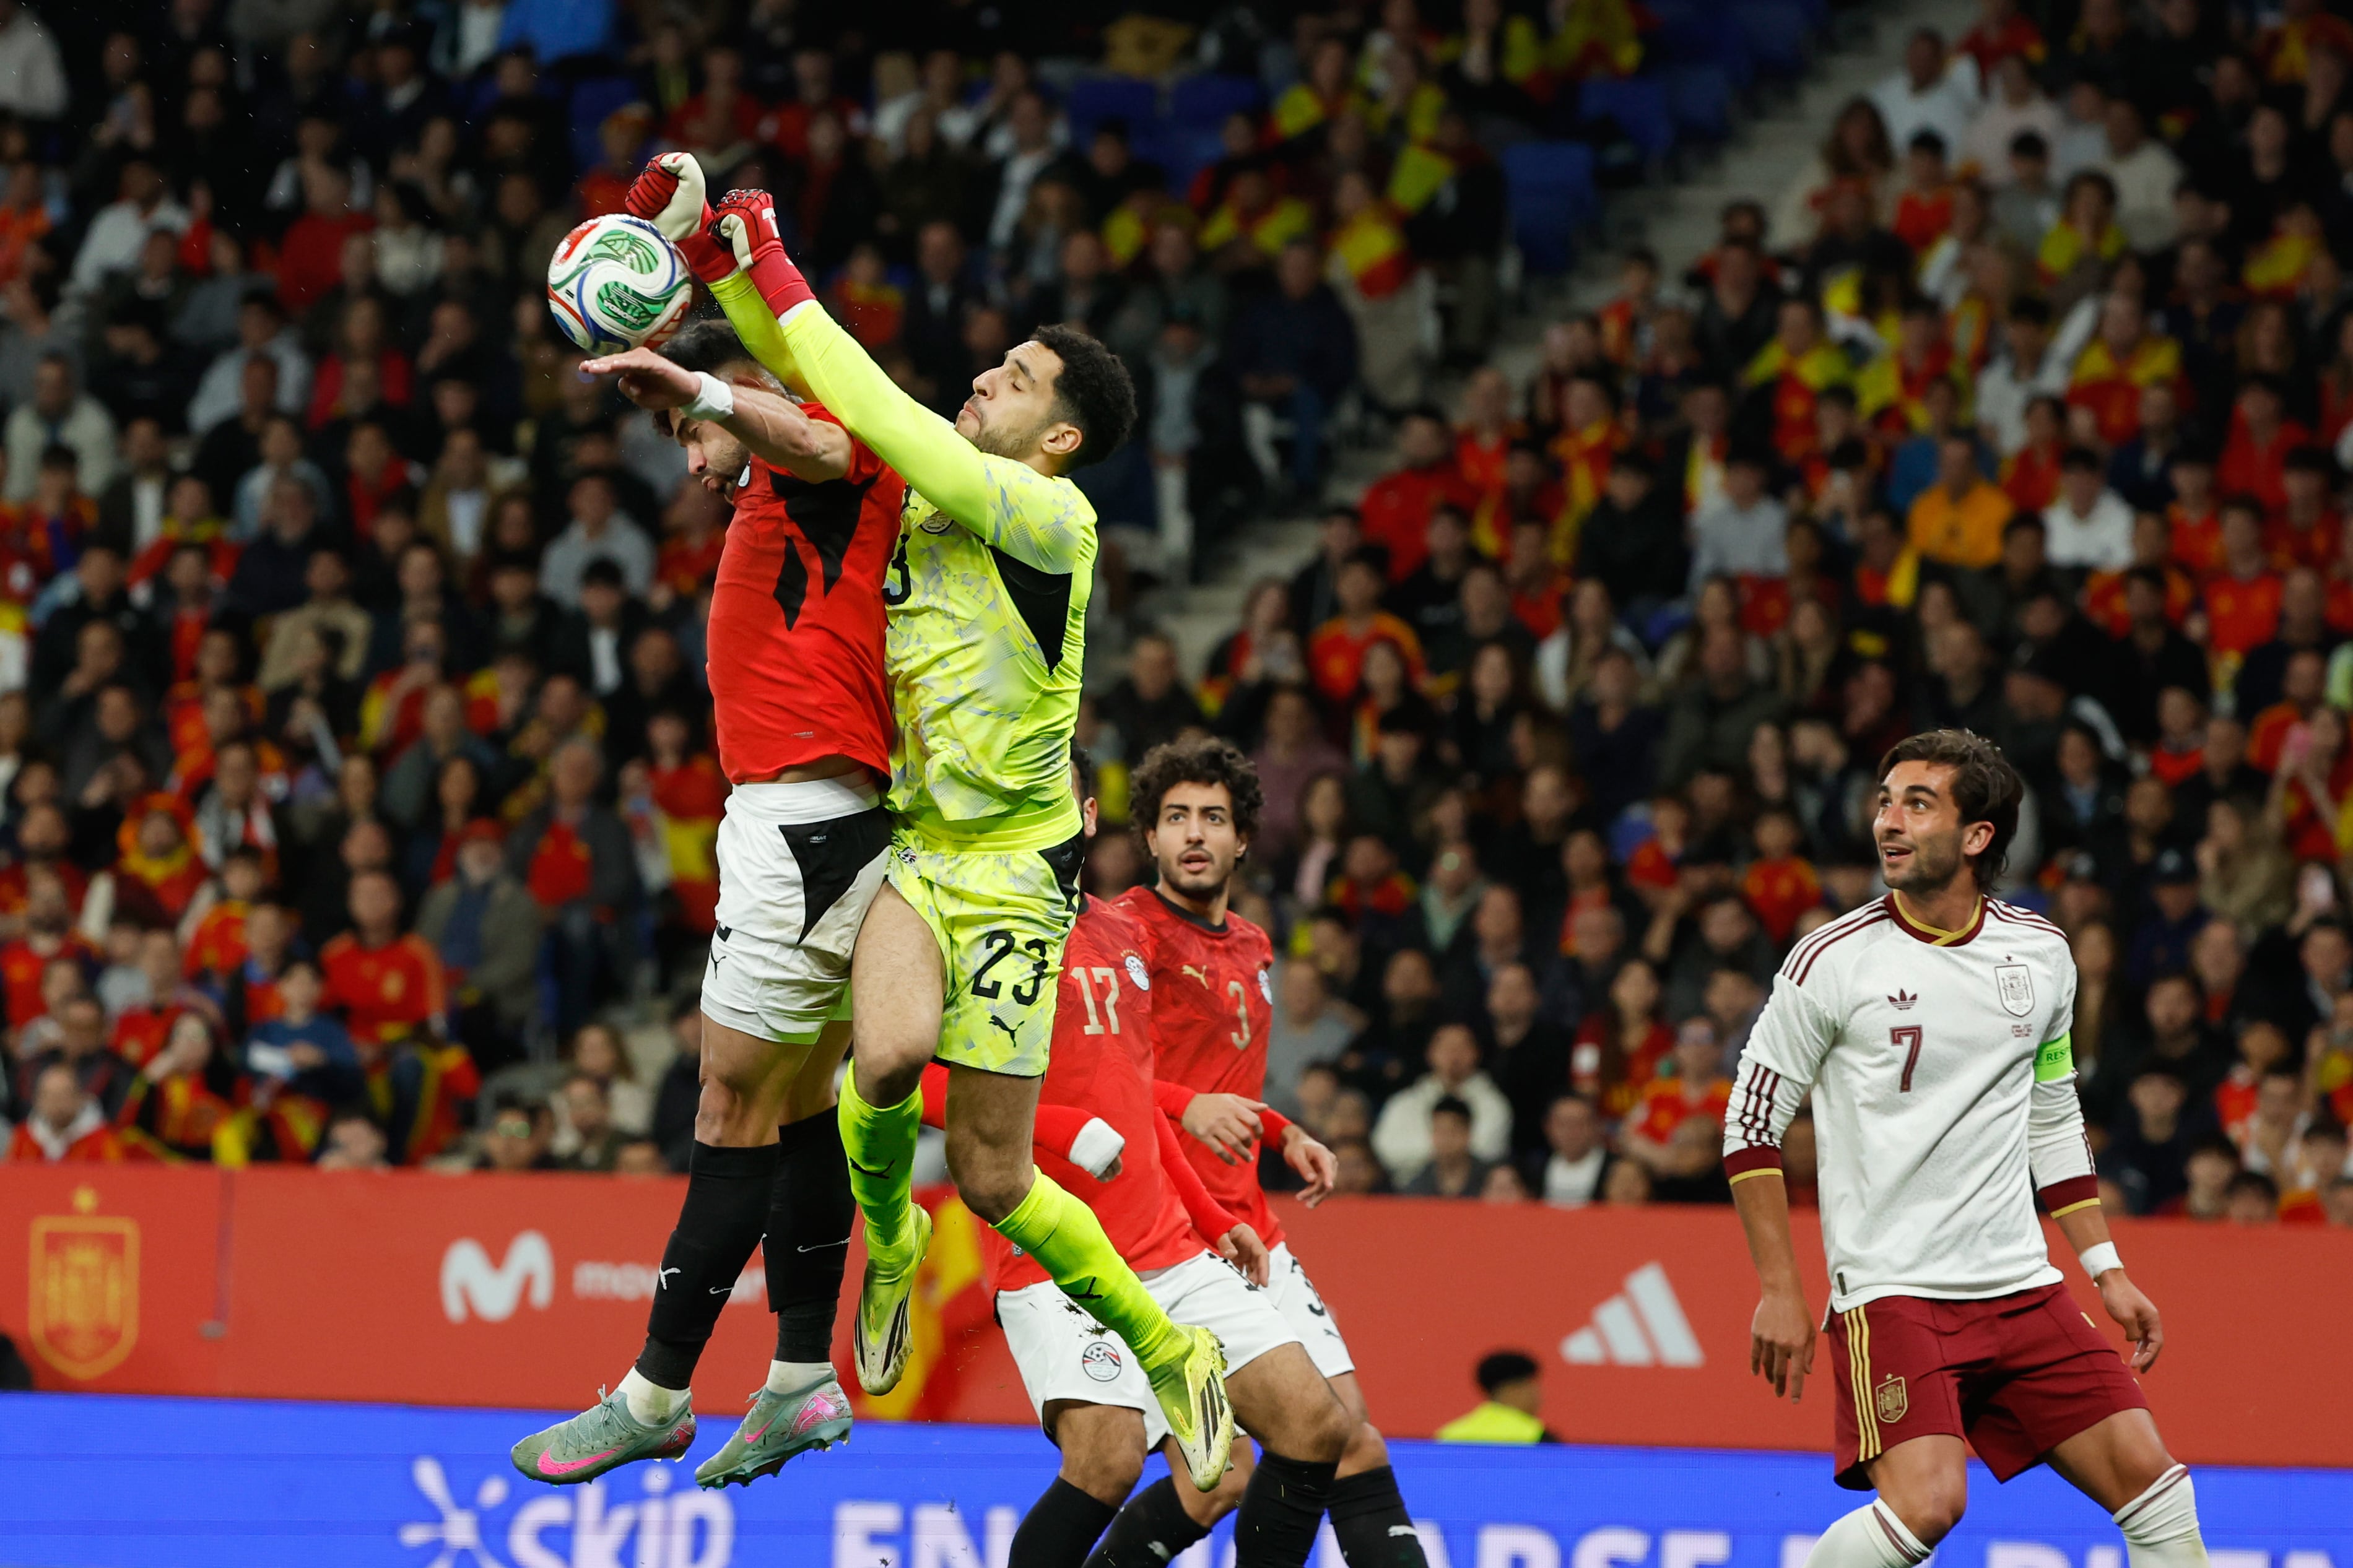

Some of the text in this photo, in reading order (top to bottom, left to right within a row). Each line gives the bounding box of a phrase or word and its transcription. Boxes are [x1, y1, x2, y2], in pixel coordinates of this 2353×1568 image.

[971, 930, 1049, 1006] 23
[1070, 966, 1121, 1035] 17
[1229, 981, 1251, 1050] 3
[1890, 1024, 1923, 1093] 7
